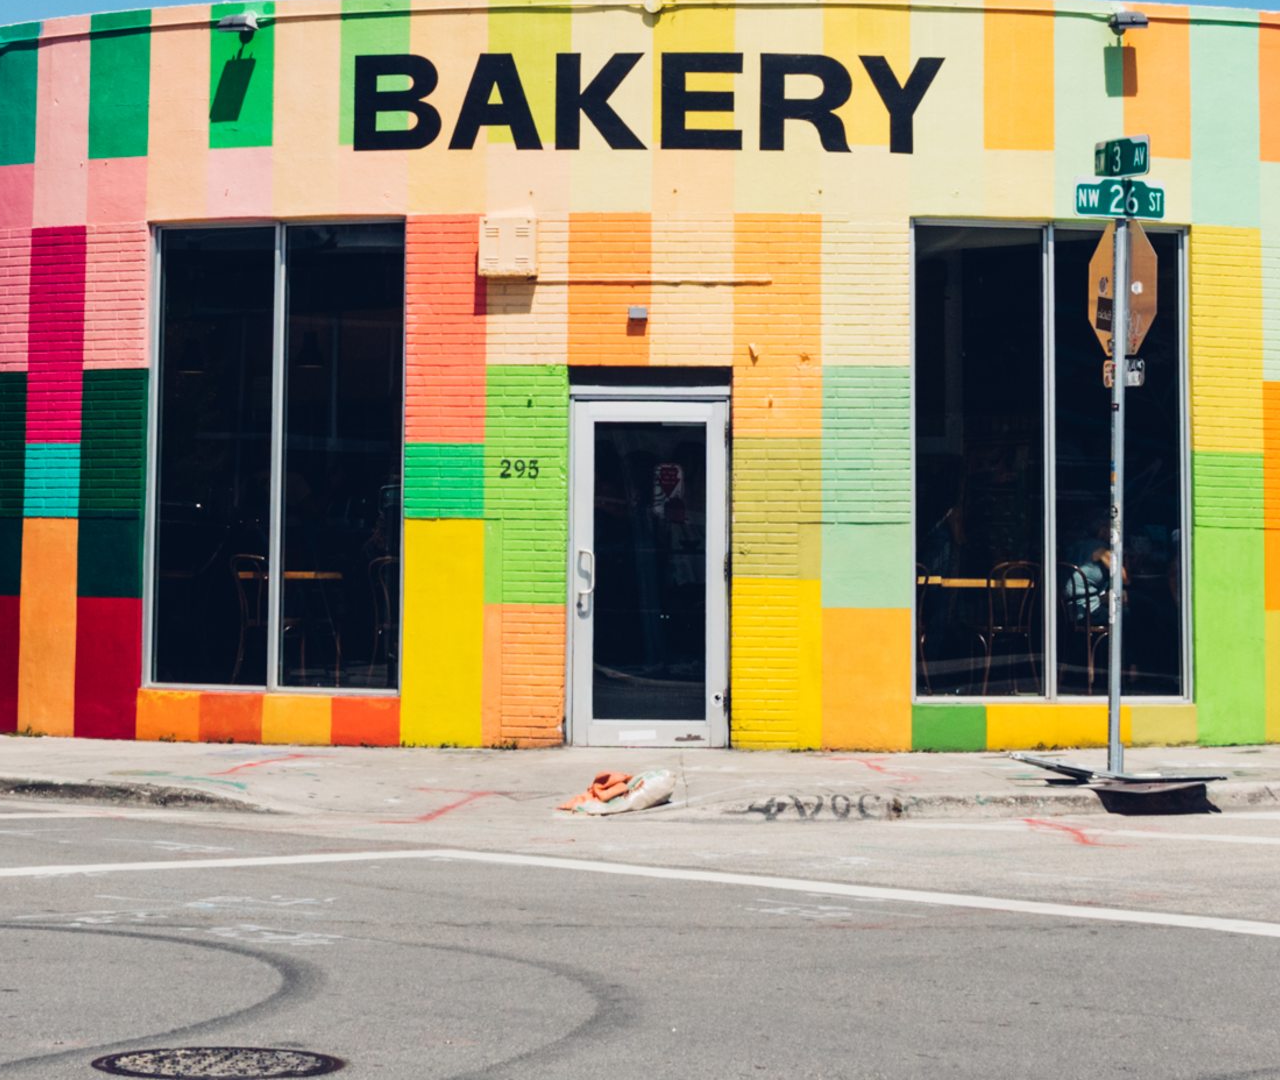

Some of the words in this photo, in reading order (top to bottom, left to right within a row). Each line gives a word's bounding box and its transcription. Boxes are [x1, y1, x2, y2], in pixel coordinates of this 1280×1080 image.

[353, 52, 945, 154] BAKERY
[1112, 145, 1122, 172] 3
[1133, 146, 1146, 167] AV
[1078, 188, 1100, 208] NW
[1109, 184, 1139, 214] 26
[1148, 191, 1162, 212] ST
[500, 459, 539, 479] 295
